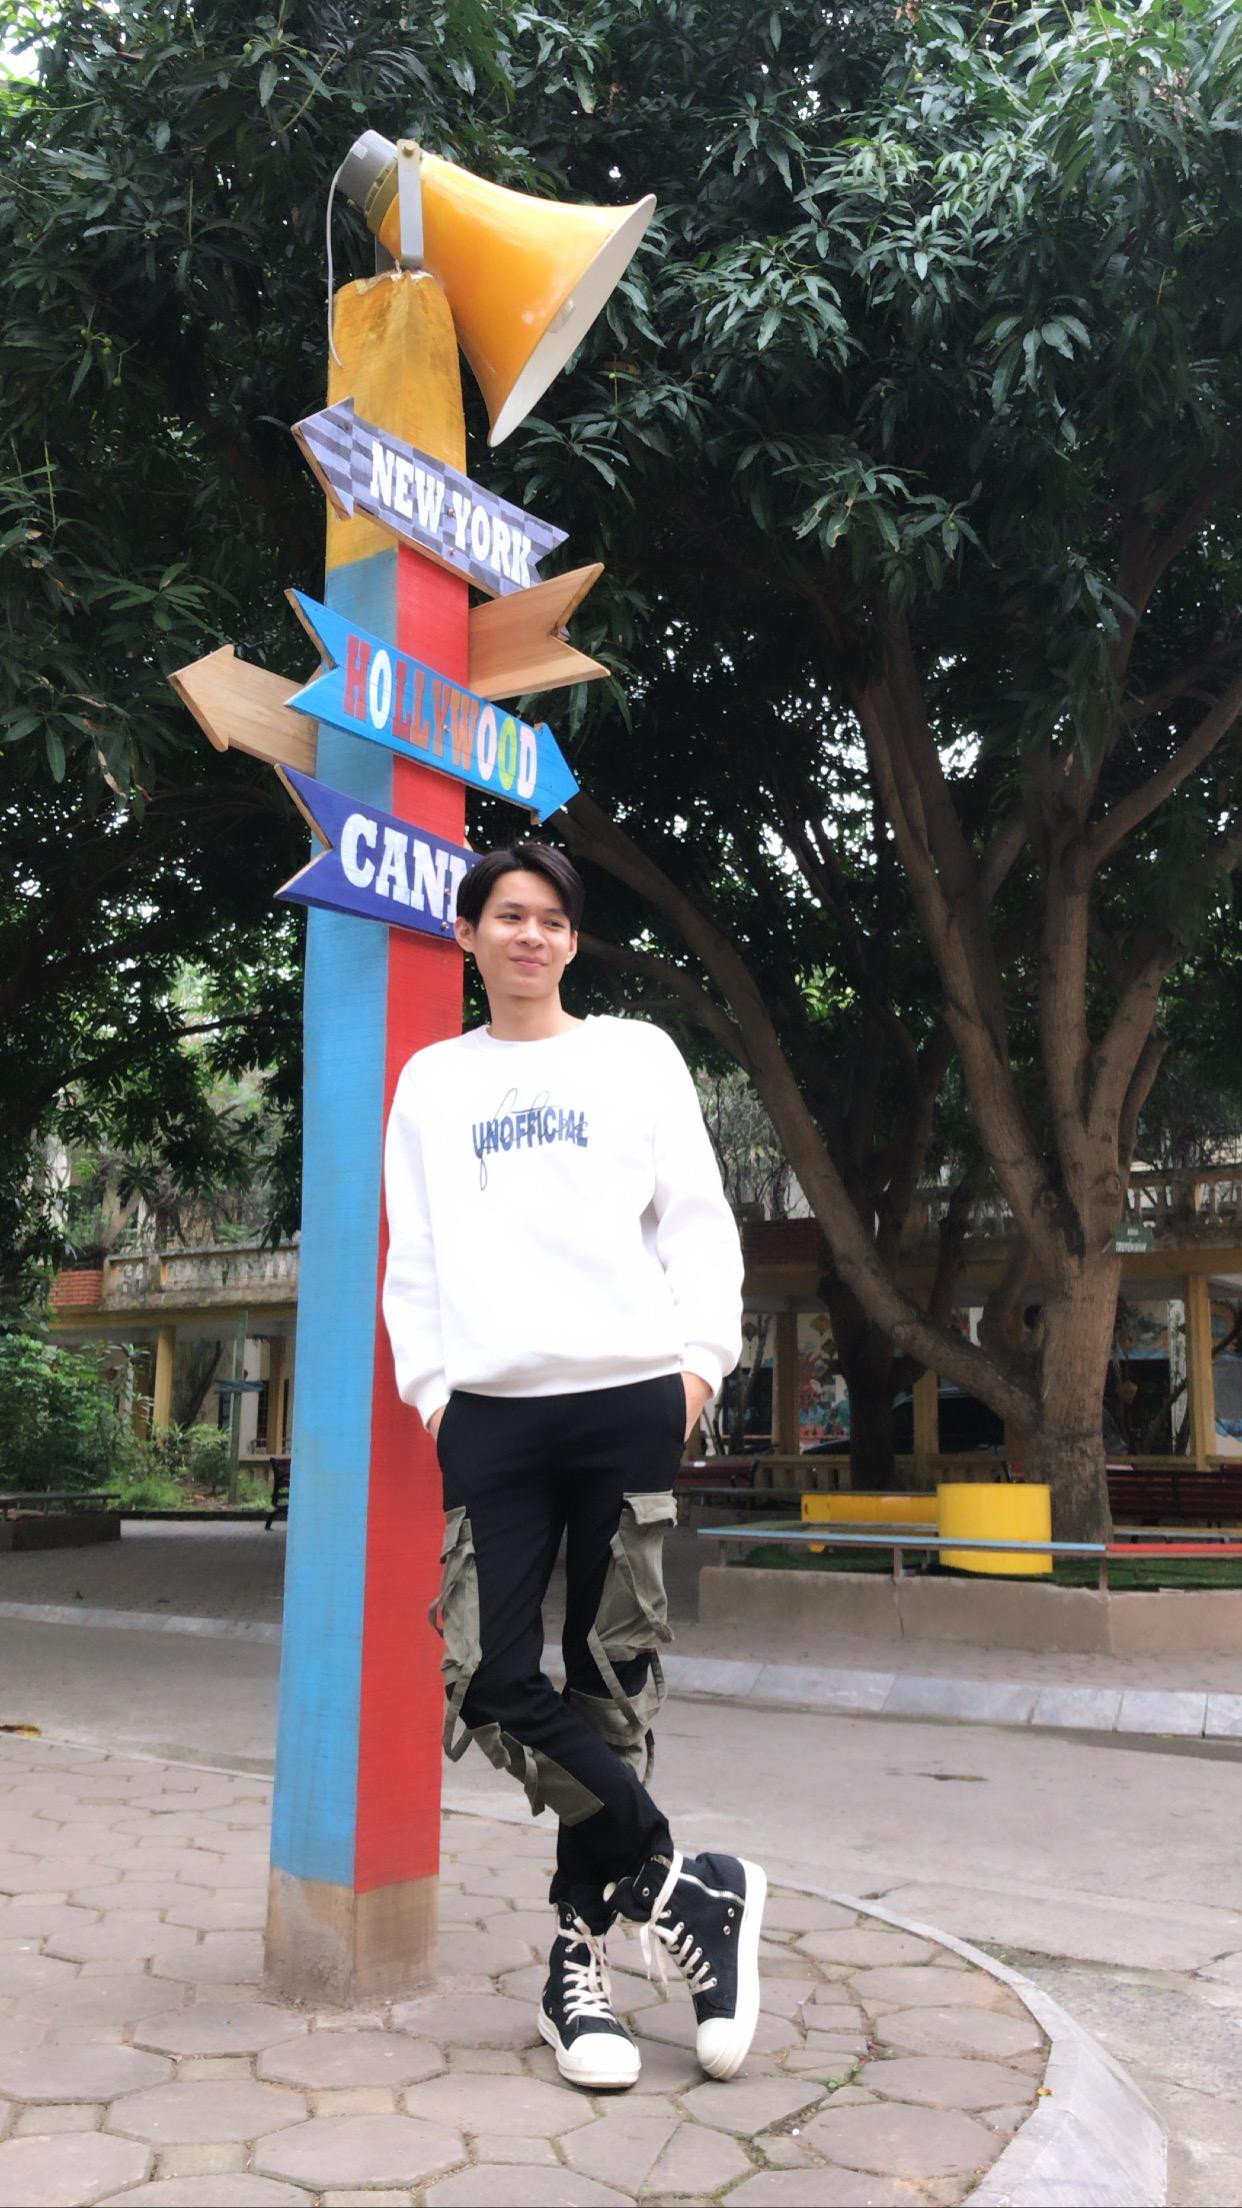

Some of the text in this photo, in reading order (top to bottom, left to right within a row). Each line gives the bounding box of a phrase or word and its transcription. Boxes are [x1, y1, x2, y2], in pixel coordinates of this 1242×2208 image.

[369, 441, 531, 588] NEW YORK
[343, 632, 538, 799] HOLLYWOOD
[472, 1106, 588, 1160] UNOFFICIAL
